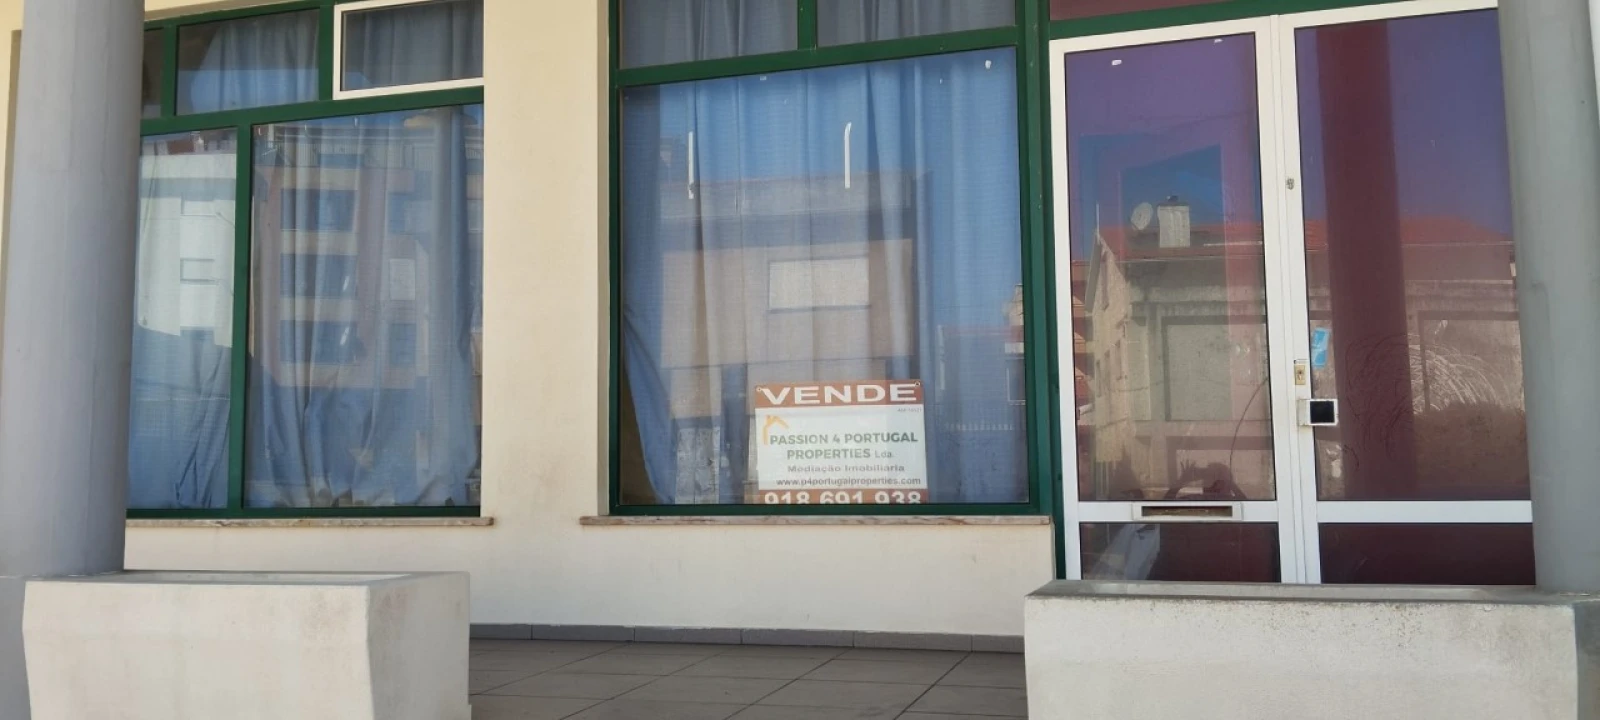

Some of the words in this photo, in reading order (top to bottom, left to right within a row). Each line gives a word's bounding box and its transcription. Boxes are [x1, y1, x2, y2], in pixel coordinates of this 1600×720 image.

[761, 383, 917, 405] VENDE
[770, 434, 828, 445] PASSION
[833, 434, 840, 444] 4
[844, 432, 918, 443] PORTUGAL
[787, 448, 871, 460] PROPERTIES
[787, 464, 841, 473] Mediação
[776, 477, 921, 487] www.p4portugalproperties.com
[764, 491, 810, 504] 918
[820, 491, 863, 504] 691
[874, 490, 921, 504] 938
